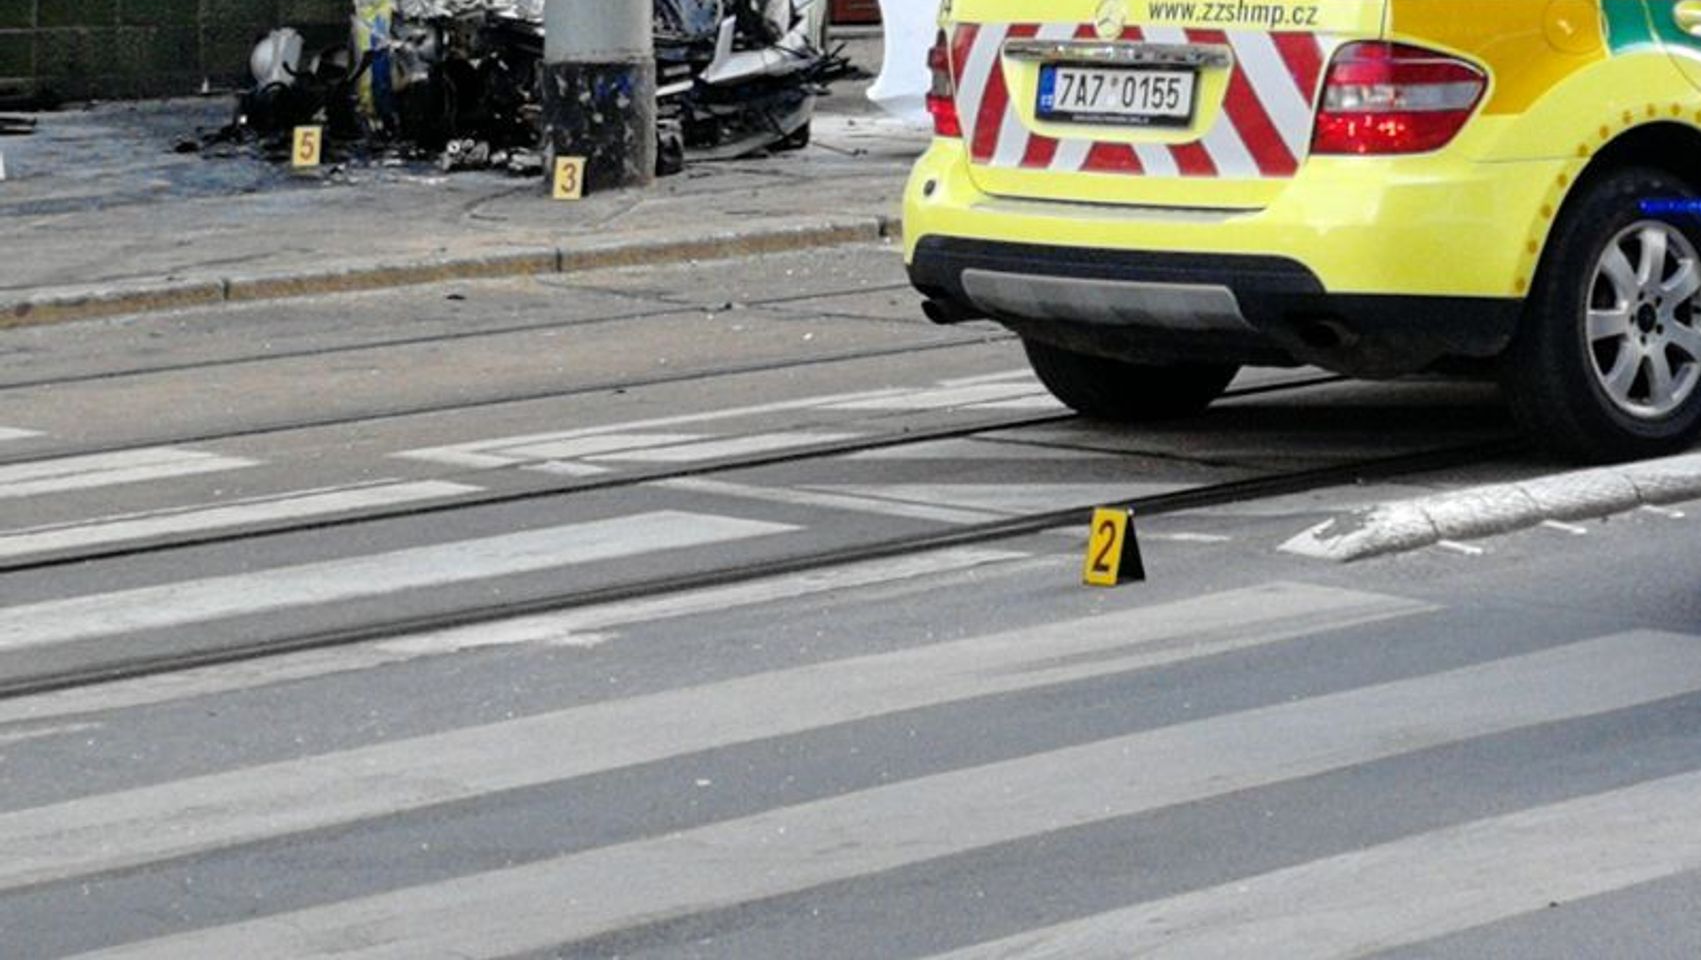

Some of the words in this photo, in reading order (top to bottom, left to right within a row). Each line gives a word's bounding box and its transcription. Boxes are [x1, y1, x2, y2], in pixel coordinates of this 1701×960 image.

[1059, 73, 1105, 107] 7A7
[1122, 76, 1181, 109] 0155
[300, 131, 315, 161] 5
[560, 162, 577, 193] 3
[1092, 520, 1117, 572] 2
